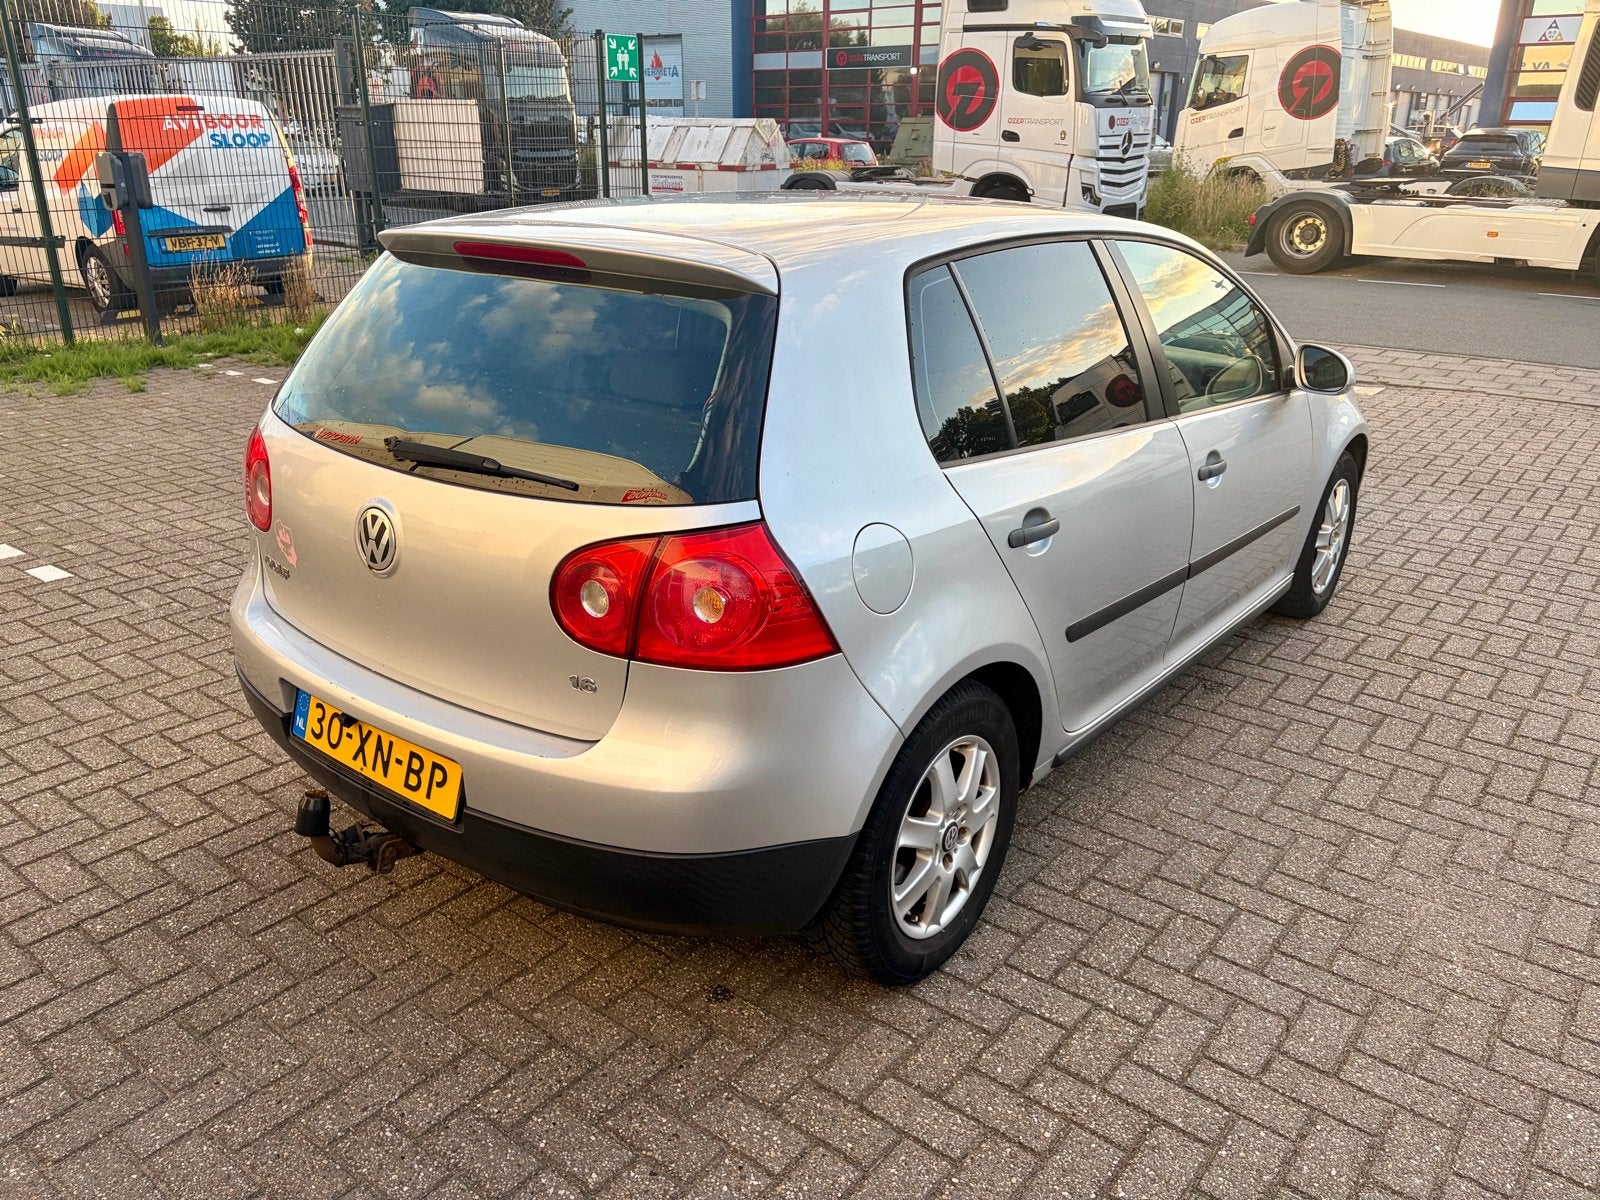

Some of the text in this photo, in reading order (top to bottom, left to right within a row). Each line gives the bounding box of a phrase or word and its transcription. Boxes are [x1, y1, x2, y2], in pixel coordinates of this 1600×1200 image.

[210, 133, 271, 148] SLOOP
[169, 235, 220, 249] VBF-37-V
[295, 715, 306, 731] NL
[310, 702, 448, 800] 30-XN-BP
